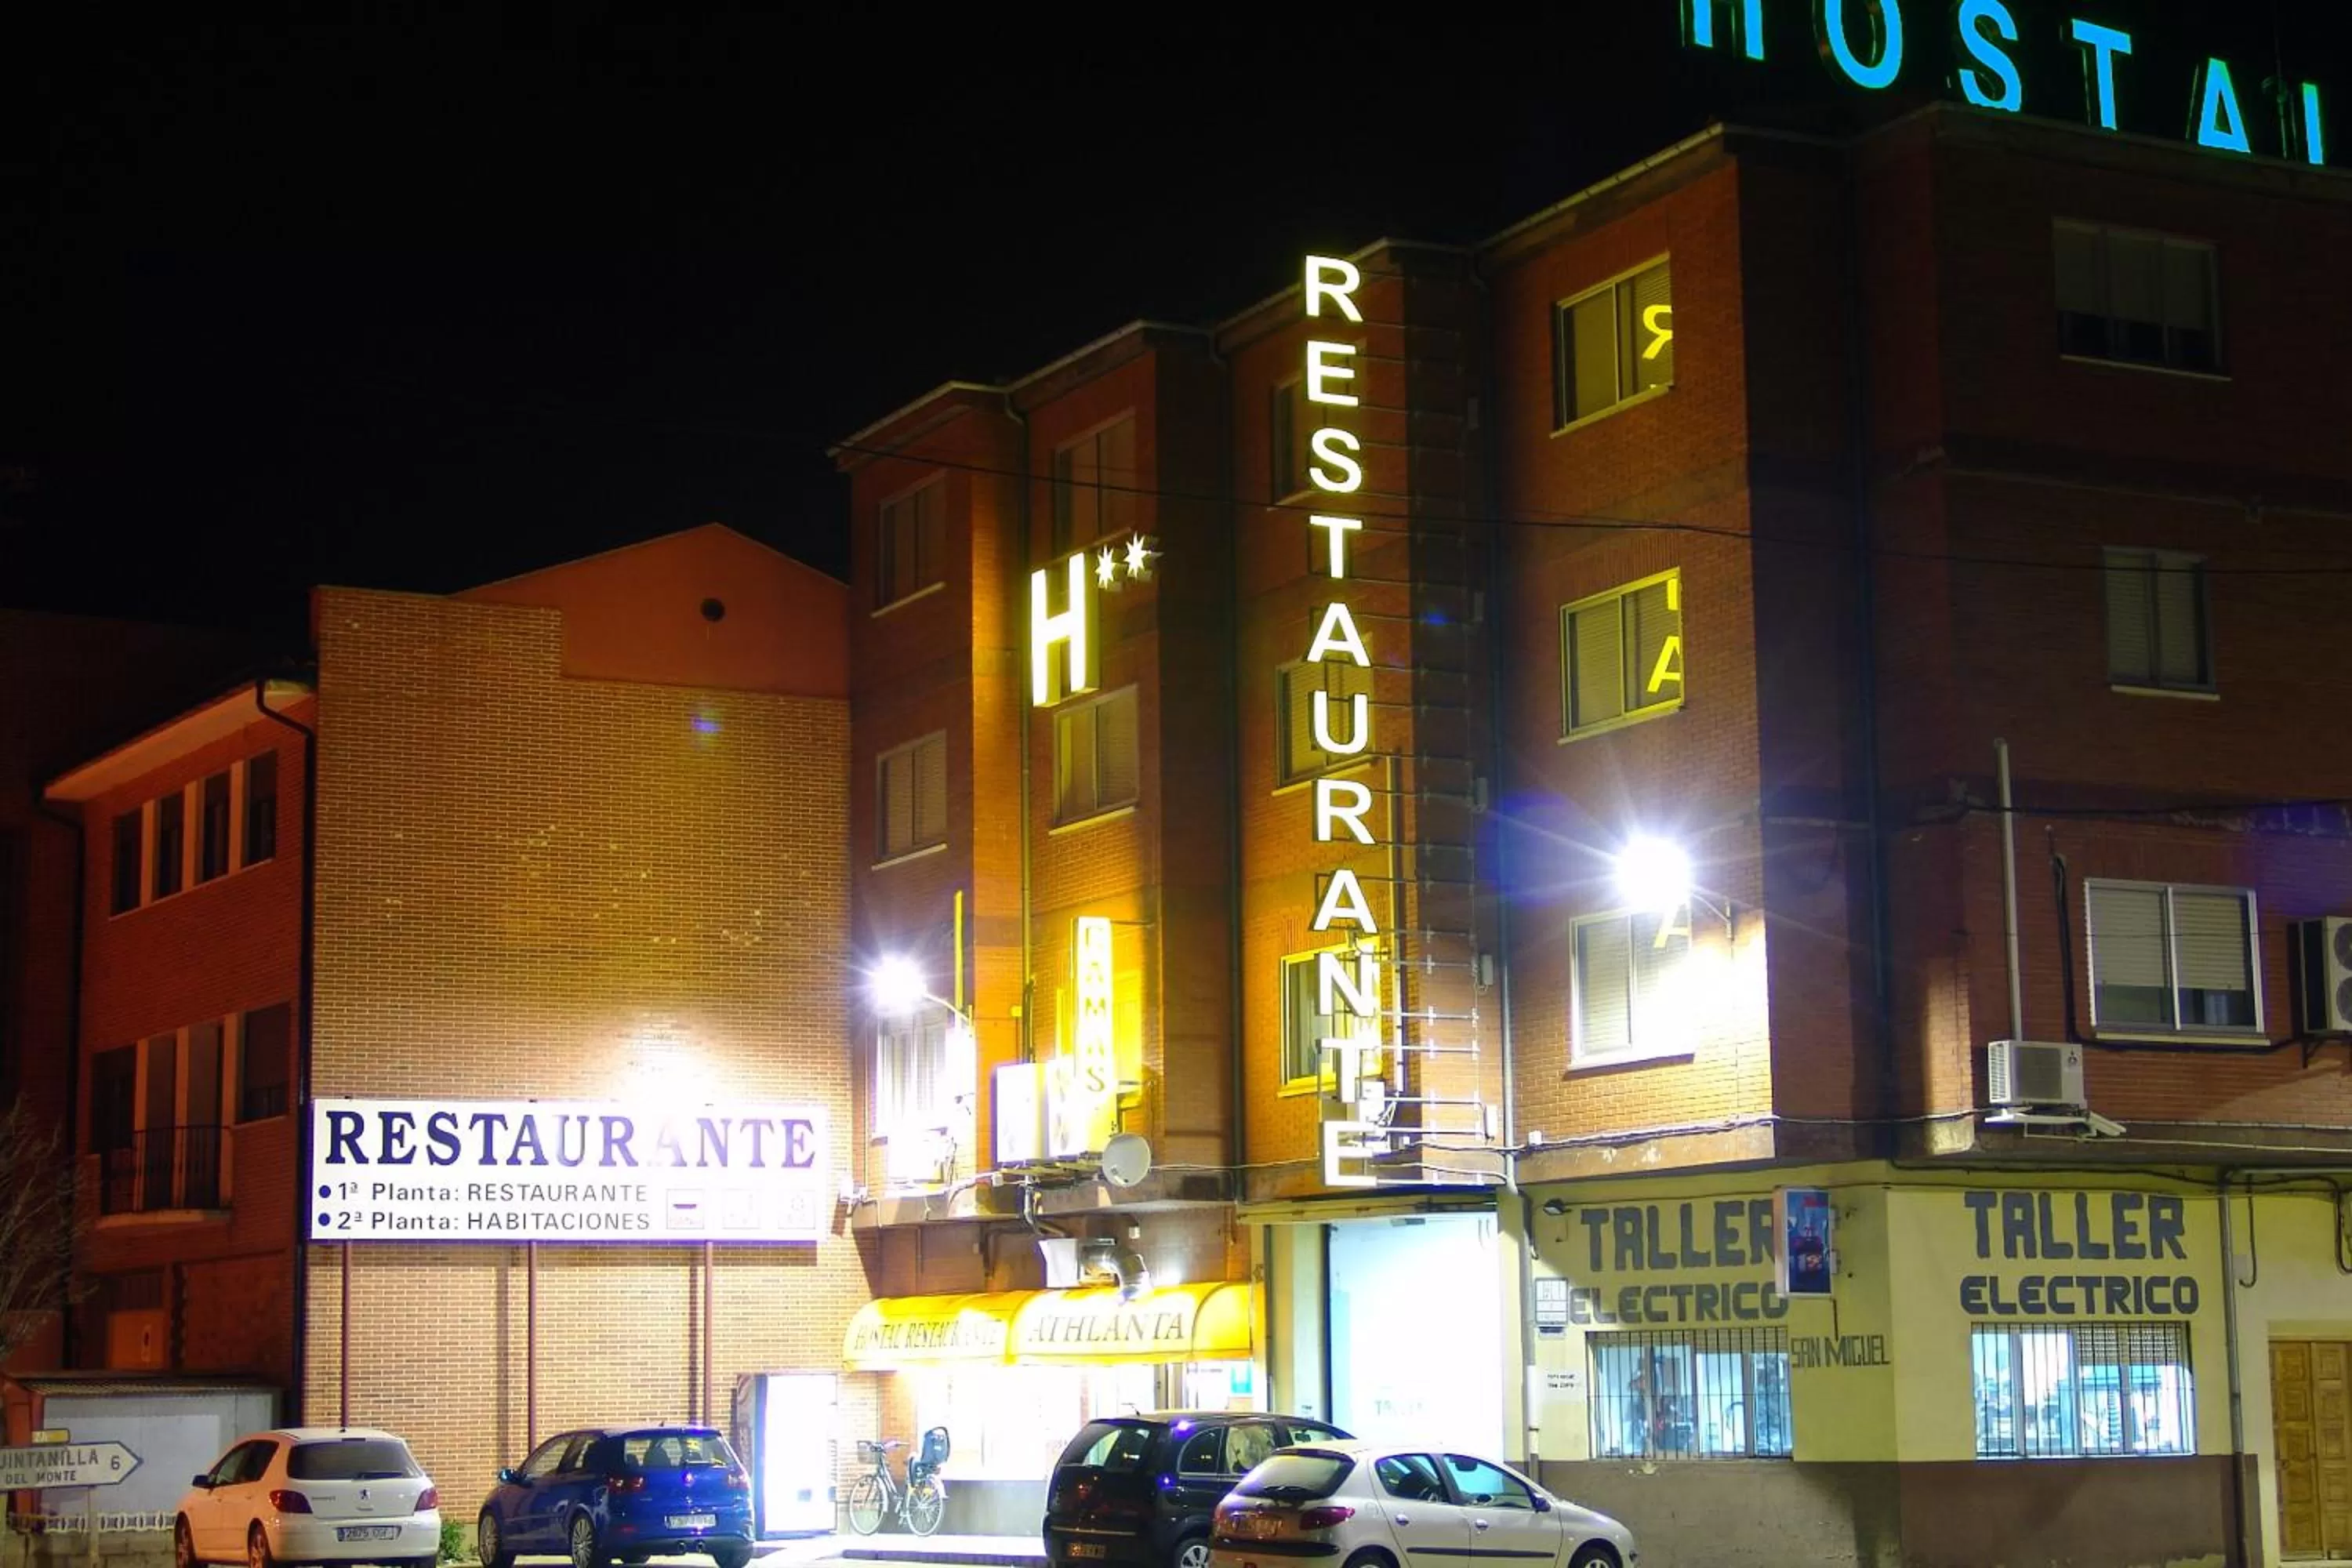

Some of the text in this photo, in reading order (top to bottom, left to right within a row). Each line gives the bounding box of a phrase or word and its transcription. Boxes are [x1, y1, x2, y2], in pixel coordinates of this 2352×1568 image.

[1031, 553, 1085, 705] H
[1305, 255, 1379, 1186] RESTAURANTE
[325, 1110, 816, 1168] RESTAURANTE
[372, 1182, 459, 1201] Planta:
[467, 1184, 648, 1202] RESTAURANTE
[371, 1211, 459, 1230] Planta:
[467, 1212, 650, 1230] HABITACIONES
[1581, 1198, 1775, 1272] TALLER
[1965, 1191, 2189, 1260] TALLER
[1568, 1280, 1788, 1325] ELECTRICO
[1960, 1275, 2198, 1315] ELECTRICO
[1028, 1312, 1185, 1344] ATHLANTA
[1791, 1334, 1891, 1368] SAN MIGUEL
[5, 1470, 76, 1485] DEL MONTE
[111, 1456, 122, 1471] 6
